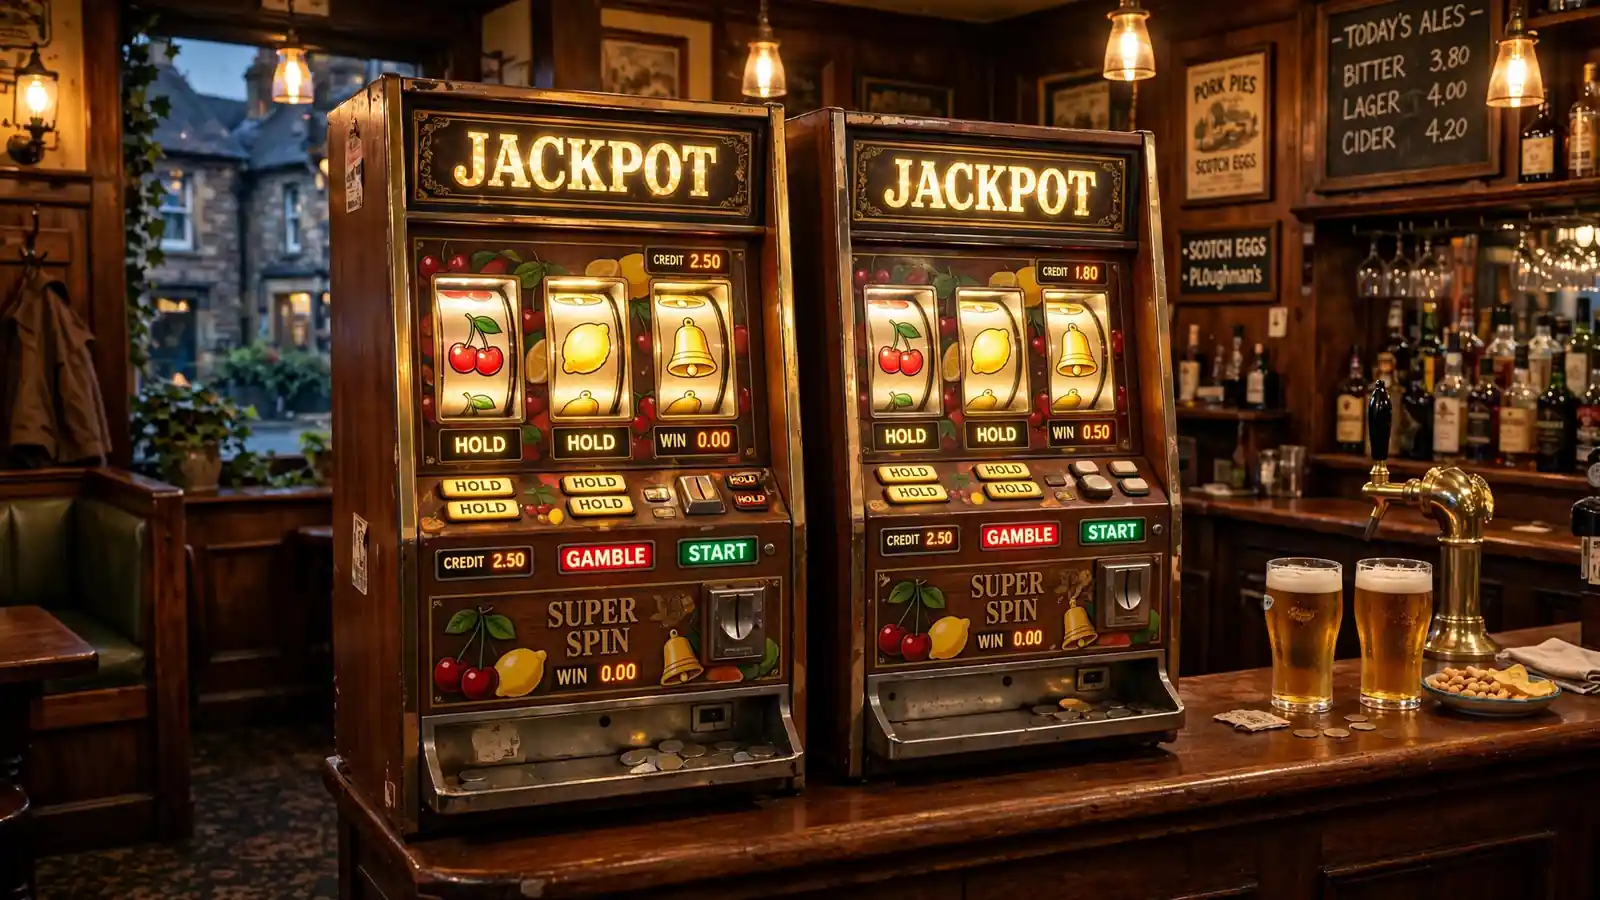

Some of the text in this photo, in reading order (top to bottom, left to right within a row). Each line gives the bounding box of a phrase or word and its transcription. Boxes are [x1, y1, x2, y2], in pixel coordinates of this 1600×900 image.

[1343, 45, 1470, 88] BITTER 3.80
[1194, 74, 1257, 104] PORK PIES
[1343, 80, 1467, 121] LAGER 4.00
[1342, 117, 1468, 155] CIDER 4.20
[453, 130, 718, 198] JACKPOT
[1195, 152, 1257, 176] SCOTCH EGGS
[883, 157, 1097, 217] JACKPOT
[1188, 236, 1267, 260] SCOTCH EGGS
[652, 253, 721, 270] CREDIT 2.50
[1042, 264, 1099, 281] CREDIT 1.80
[660, 431, 731, 448] WIN 0.00
[885, 428, 927, 444] HOLD
[977, 426, 1017, 442] HOLD
[1052, 424, 1110, 440] WIN 0.50
[454, 435, 507, 454] HOLD
[566, 433, 616, 451] HOLD
[889, 466, 929, 478] HOLD
[985, 463, 1023, 475] HOLD
[455, 480, 502, 493] HOLD
[572, 476, 617, 489] HOLD
[729, 474, 756, 485] HOLD
[995, 482, 1033, 494] HOLD
[737, 494, 766, 504] HOLD
[899, 486, 938, 498] HOLD
[460, 502, 507, 515] HOLD
[579, 498, 624, 511] HOLD
[886, 531, 953, 546] CREDIT 2.50
[986, 526, 1053, 545] GAMBLE
[1088, 523, 1137, 540] START
[443, 551, 525, 570] CREDIT 2.50
[565, 547, 646, 569] GAMBLE
[688, 543, 748, 562] START
[971, 571, 1044, 599] SUPER
[548, 597, 638, 628] SUPER
[986, 599, 1038, 625] SPIN
[566, 628, 630, 658] SPIN
[978, 629, 1043, 649] WIN 0.00
[556, 663, 637, 686] WIN 0.00
